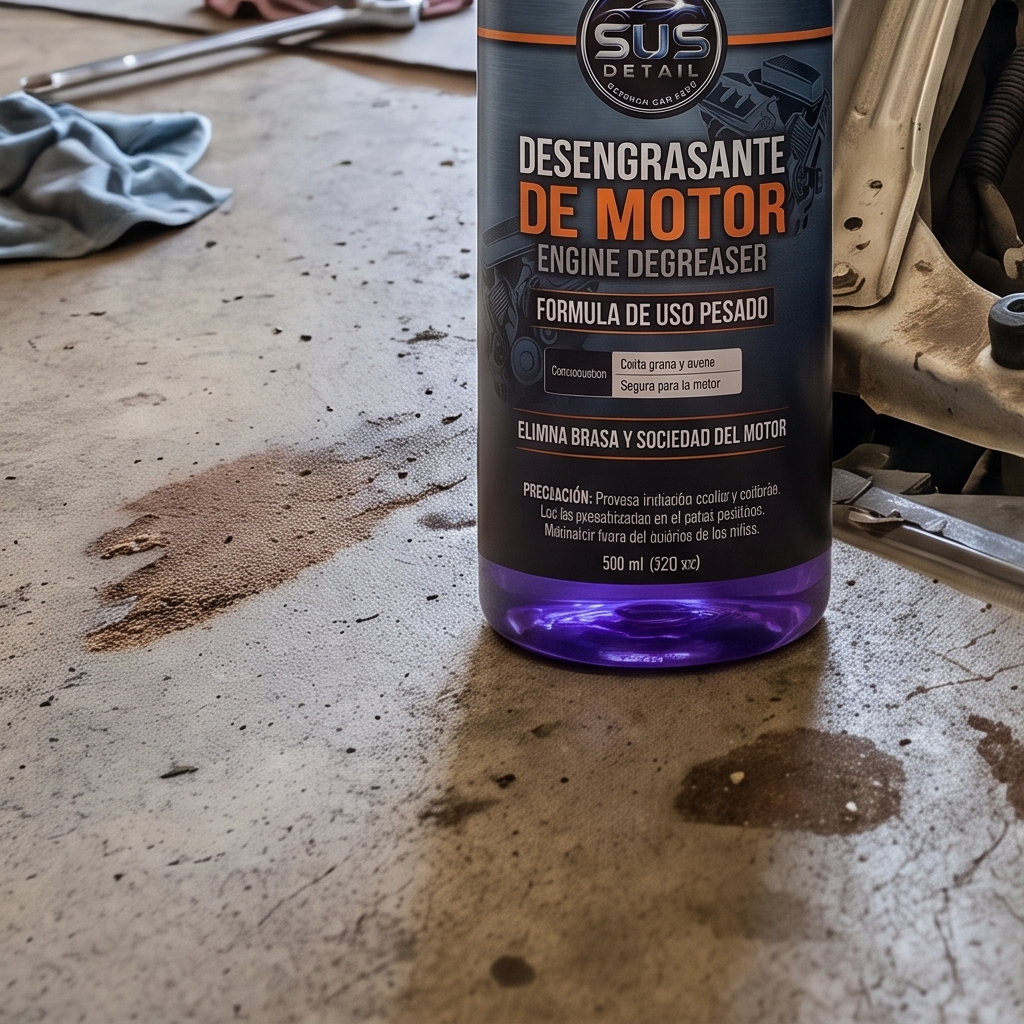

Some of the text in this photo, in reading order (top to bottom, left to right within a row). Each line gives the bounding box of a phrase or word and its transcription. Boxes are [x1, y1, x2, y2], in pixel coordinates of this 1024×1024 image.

[594, 23, 711, 60] SUS
[603, 64, 699, 79] DETAIL
[519, 135, 785, 181] DESENGRASANTE
[519, 181, 785, 241] DE MOTOR
[537, 243, 767, 278] ENGINE DEGREASER
[536, 295, 768, 326] FORMULA DE USO PESADO
[679, 360, 686, 371] y
[620, 379, 655, 394] Segura
[657, 381, 679, 393] para
[681, 379, 690, 391] la
[571, 427, 619, 449] BRASA
[623, 429, 633, 449] Y
[637, 427, 711, 449] SOCIEDAD
[715, 424, 740, 446] DEL
[744, 418, 787, 443] MOTOR
[731, 491, 738, 504] y
[654, 514, 668, 525] en
[671, 511, 681, 524] el
[629, 530, 647, 544] del
[696, 527, 709, 542] de
[712, 526, 727, 540] los
[602, 555, 625, 571] 500
[629, 555, 644, 571] ml
